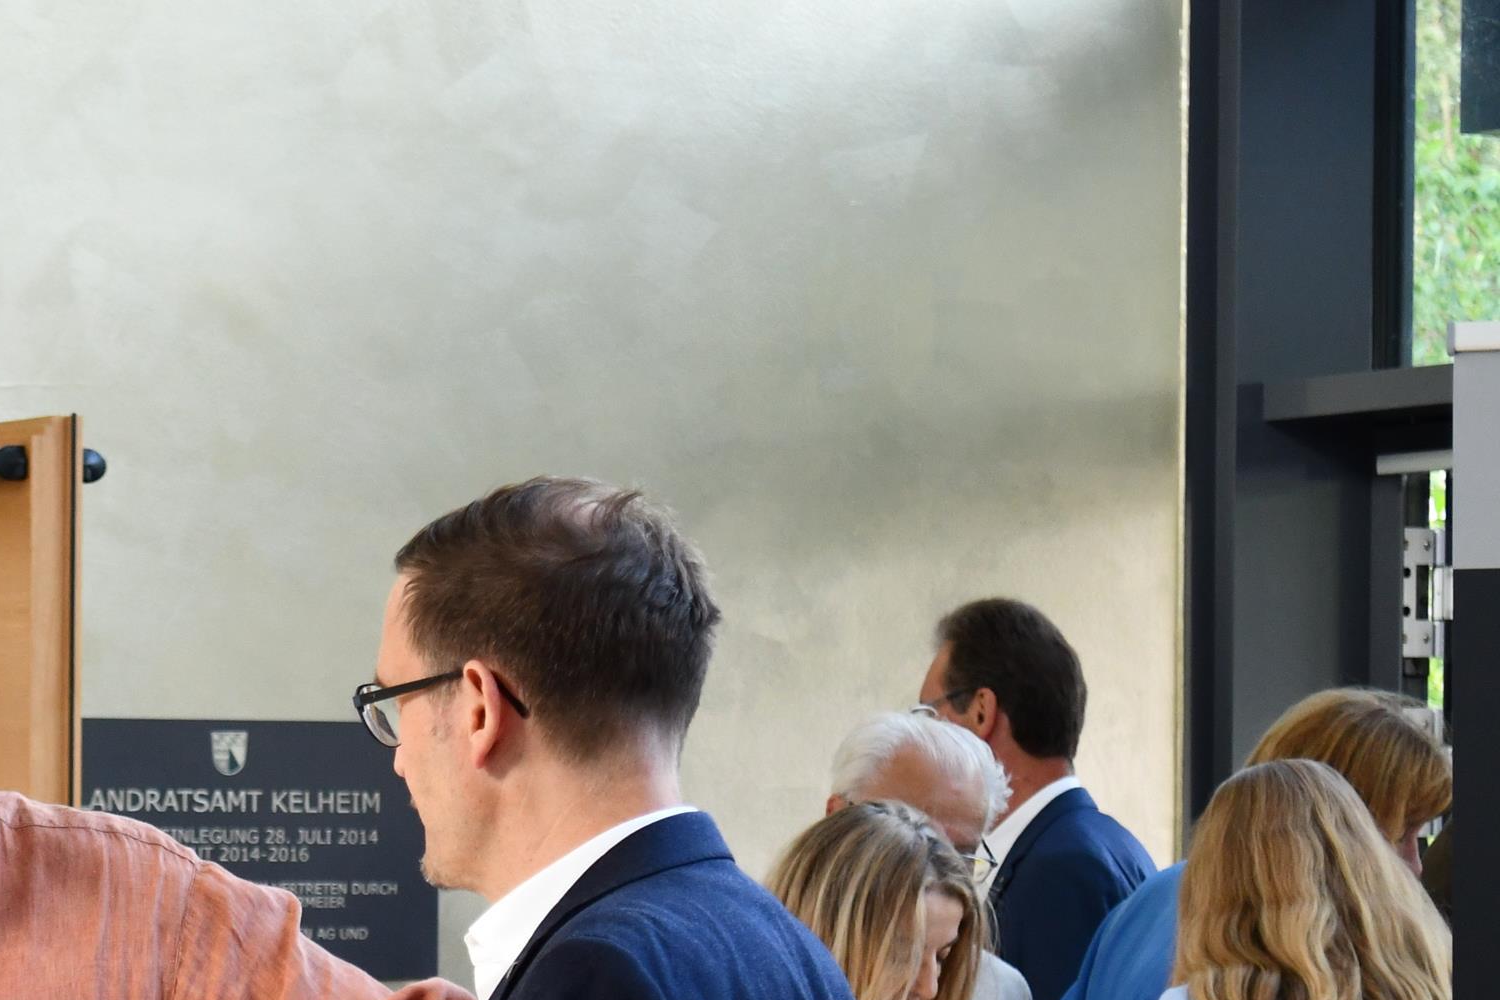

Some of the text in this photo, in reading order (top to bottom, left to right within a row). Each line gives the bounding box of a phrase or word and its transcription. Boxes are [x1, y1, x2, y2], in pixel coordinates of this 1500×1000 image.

[83, 788, 381, 814] ANDRATSAMT KELHEIM
[163, 827, 378, 845] INLEGUNG 28. JULI 2014
[220, 846, 310, 863] 2014-2016
[351, 882, 398, 896] DURCH
[317, 928, 337, 941] AG
[339, 928, 369, 941] UND
